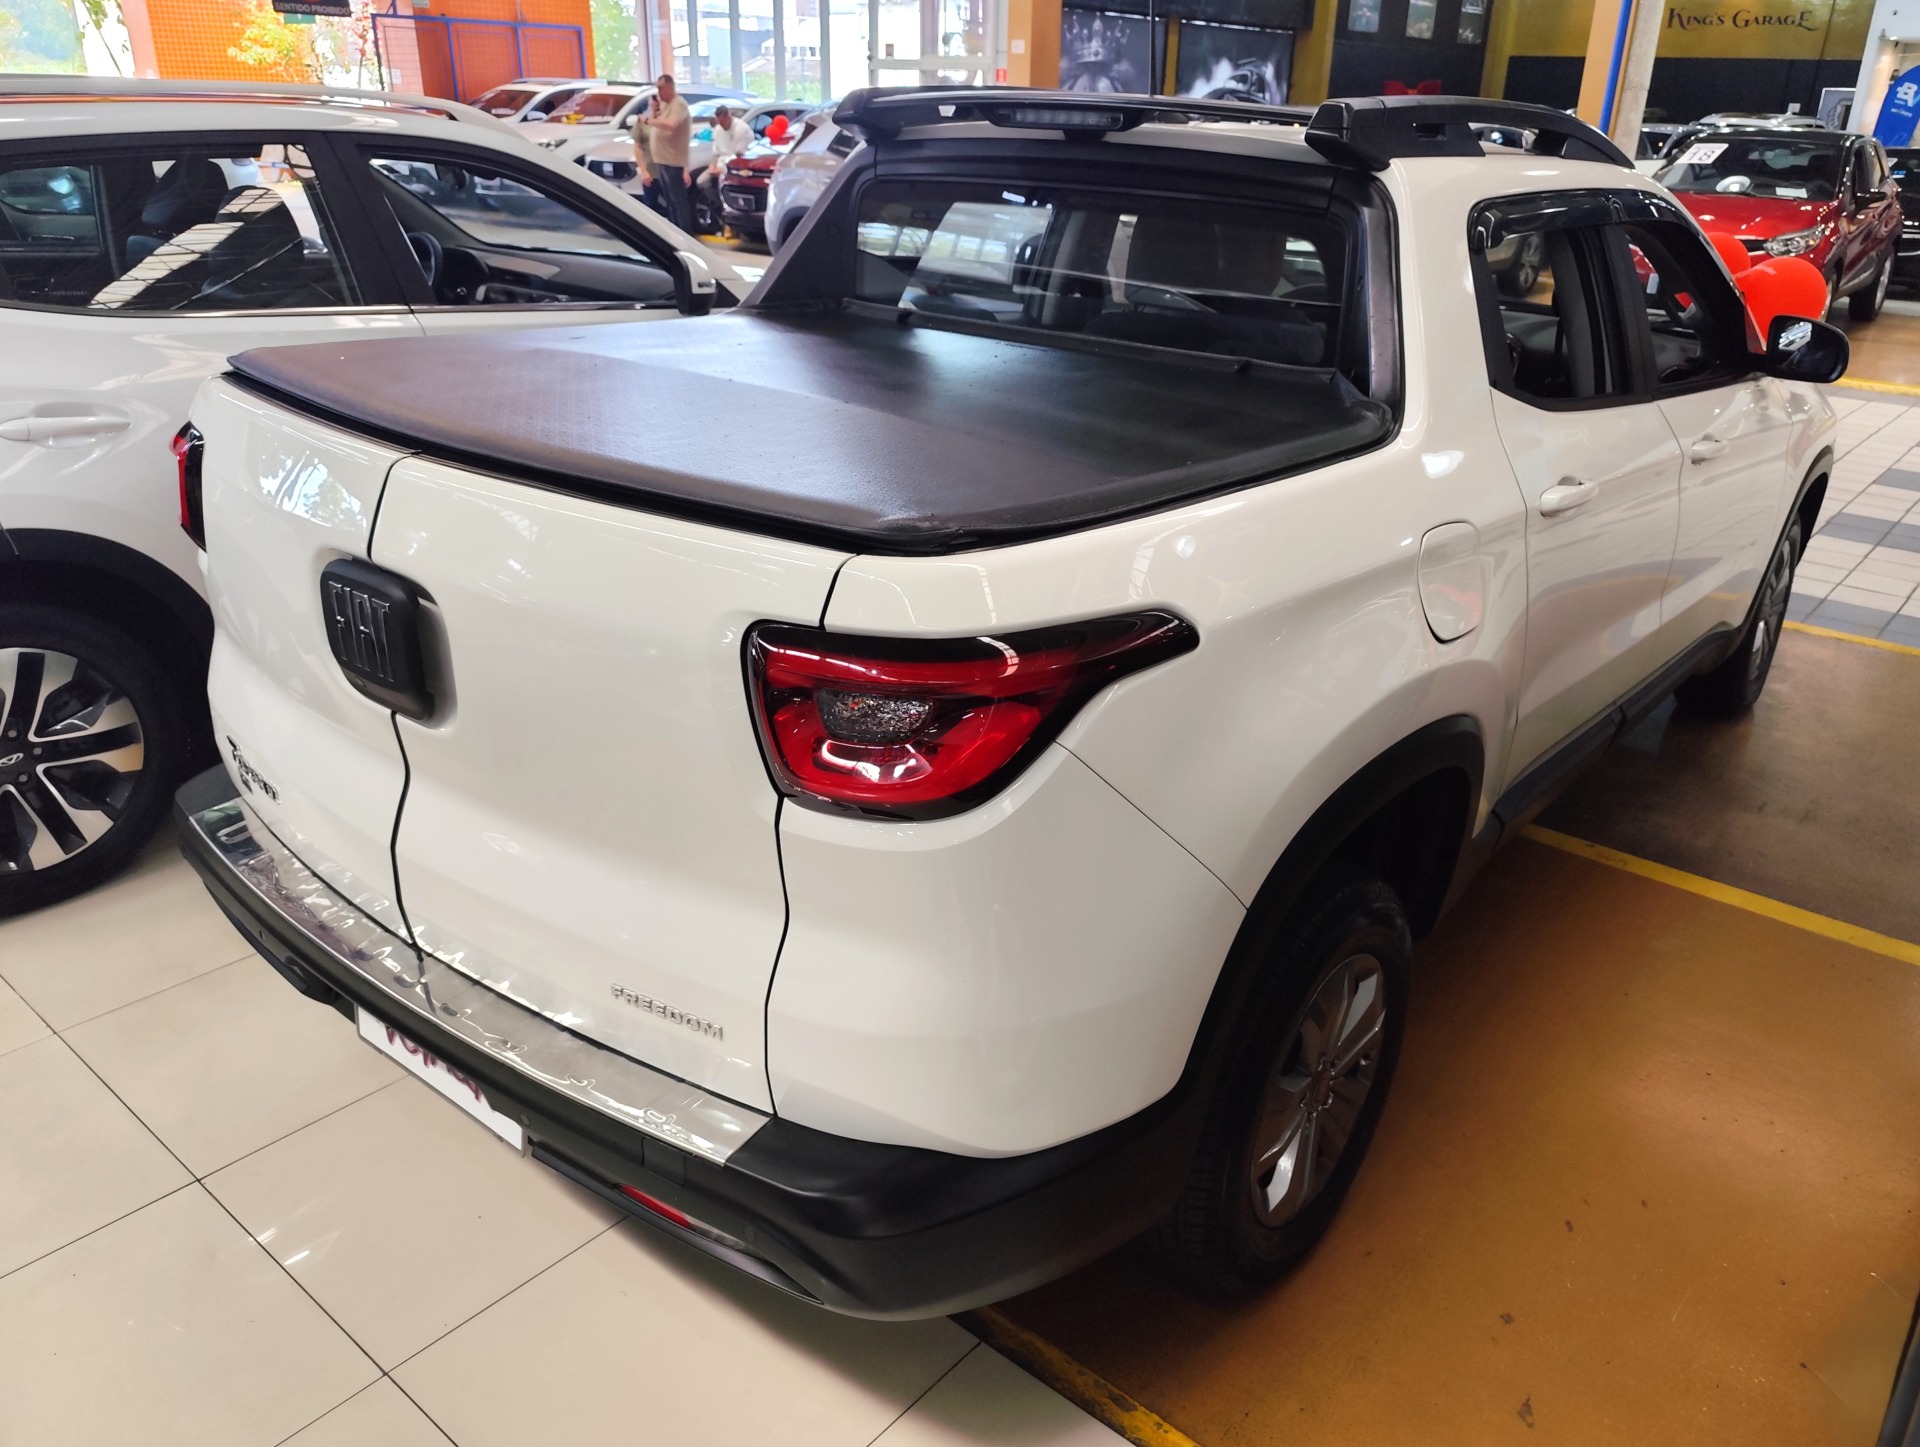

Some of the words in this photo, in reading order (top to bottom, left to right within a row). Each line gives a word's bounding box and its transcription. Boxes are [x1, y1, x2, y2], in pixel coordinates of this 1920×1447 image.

[275, 3, 311, 12] SENTIDO
[312, 5, 350, 15] PROIBIDO
[1732, 9, 1820, 32] GARAGE
[328, 580, 395, 683] FIAT
[610, 983, 724, 1041] FREEDOM
